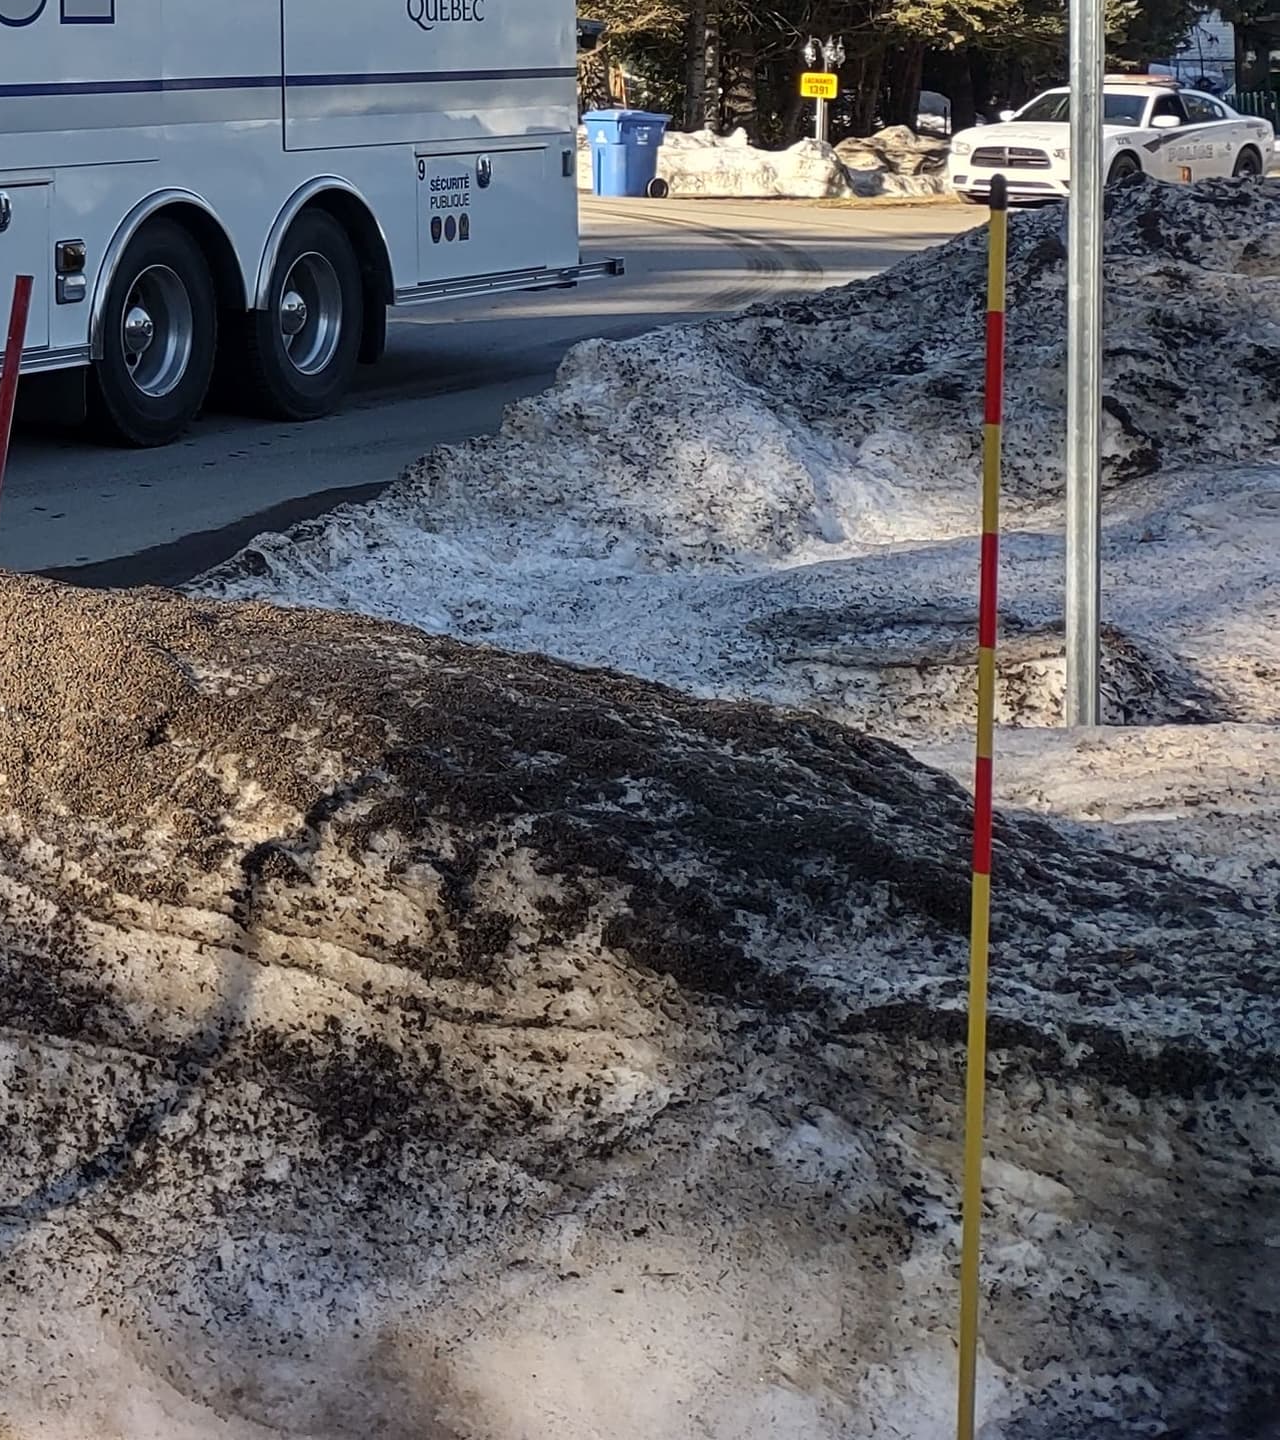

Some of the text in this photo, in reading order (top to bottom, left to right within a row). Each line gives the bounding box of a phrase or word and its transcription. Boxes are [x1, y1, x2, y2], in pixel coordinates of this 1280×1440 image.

[418, 159, 426, 181] 9
[430, 173, 470, 192] SÉCURITÉ
[430, 193, 470, 209] PUBLIQUE
